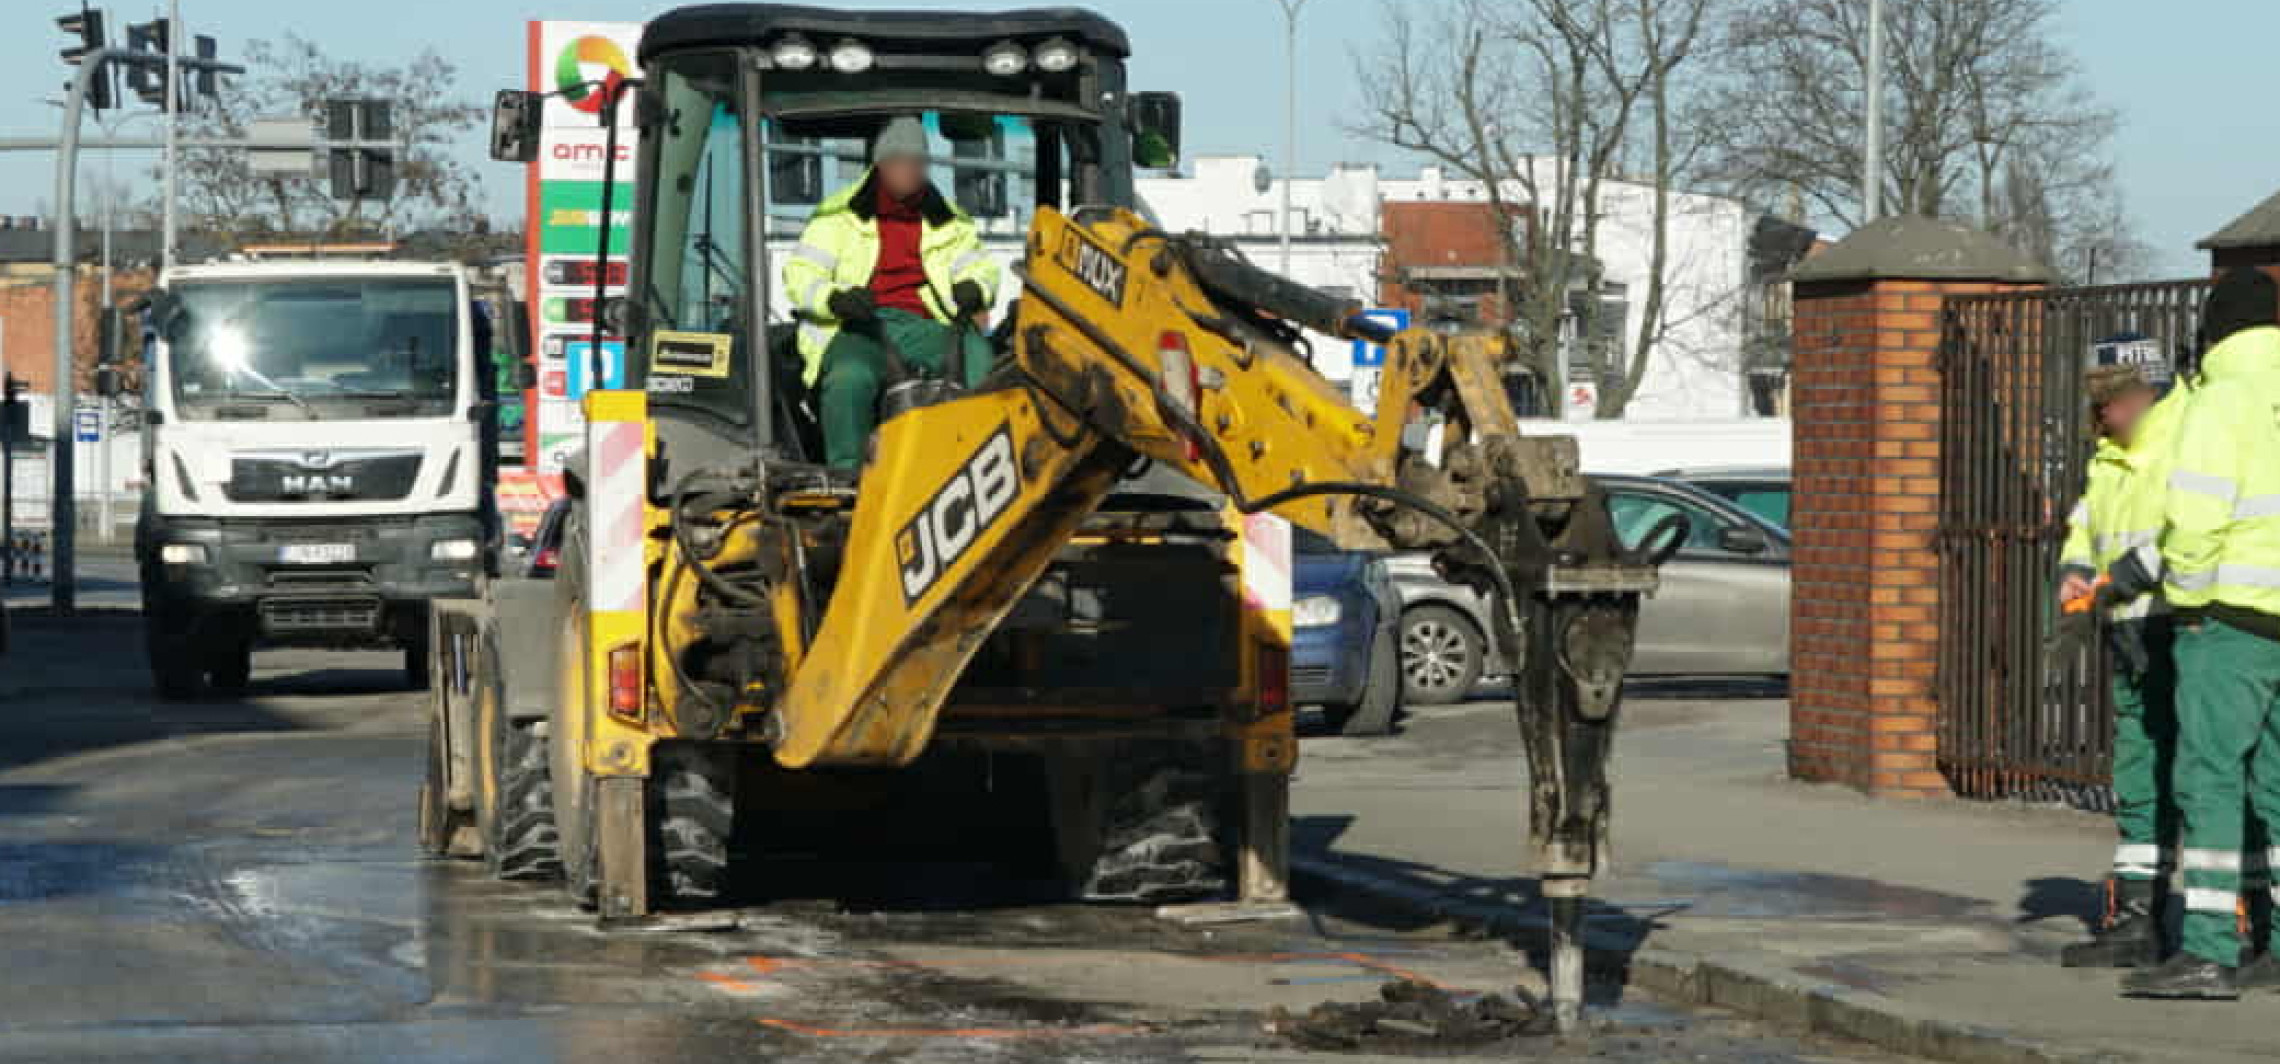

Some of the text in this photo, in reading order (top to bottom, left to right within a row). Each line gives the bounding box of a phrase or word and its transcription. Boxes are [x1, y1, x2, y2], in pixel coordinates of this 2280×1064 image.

[552, 143, 632, 161] amc
[283, 475, 352, 492] MAN
[904, 432, 1017, 597] JCB
